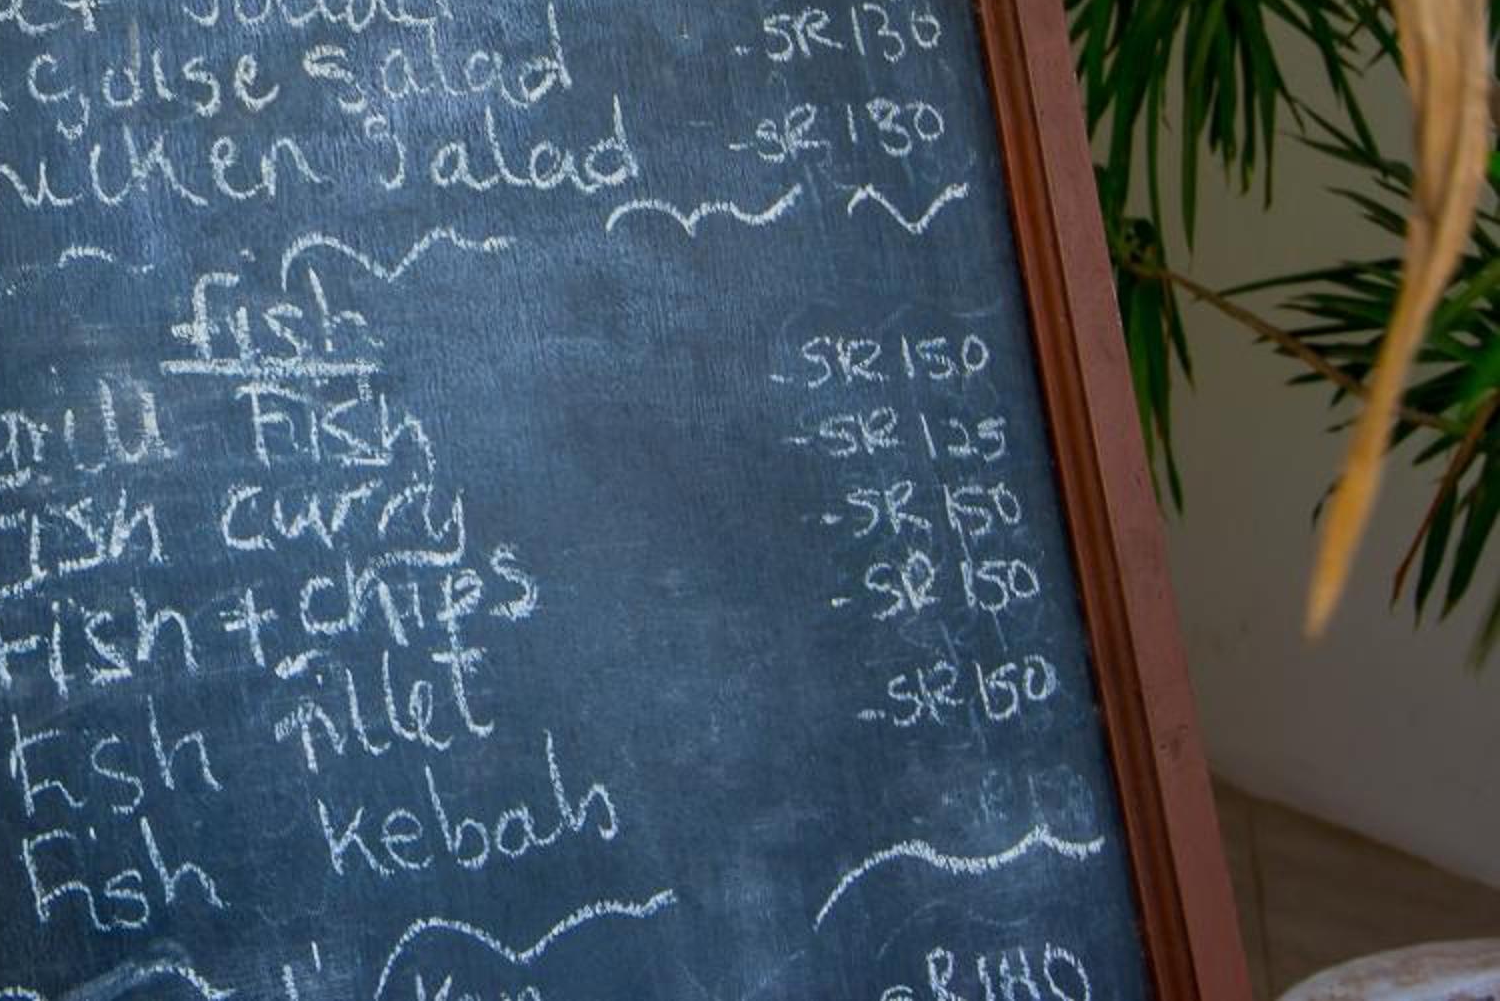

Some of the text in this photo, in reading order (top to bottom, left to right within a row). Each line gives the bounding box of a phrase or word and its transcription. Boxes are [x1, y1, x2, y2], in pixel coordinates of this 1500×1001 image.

[901, 334, 990, 381] 150
[960, 557, 1040, 612] 150
[975, 654, 1060, 721] 150
